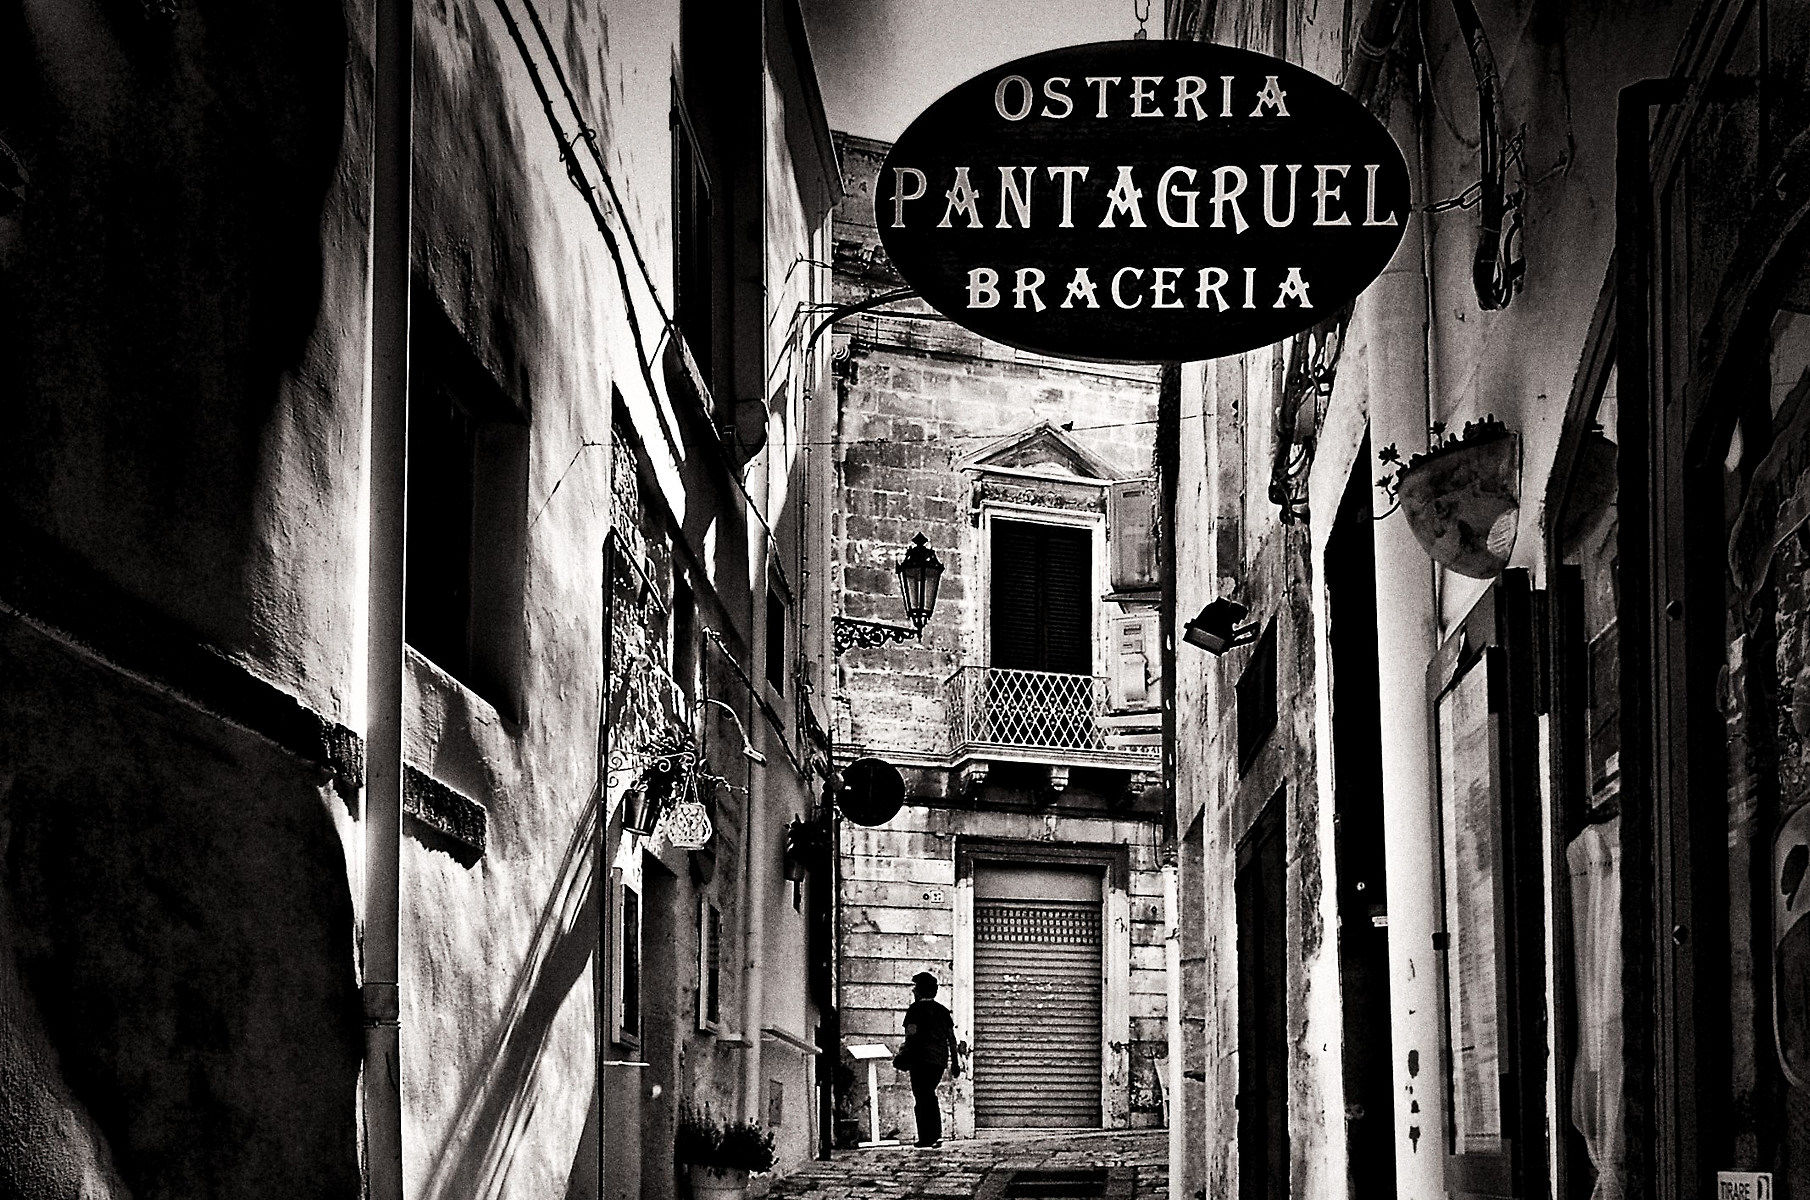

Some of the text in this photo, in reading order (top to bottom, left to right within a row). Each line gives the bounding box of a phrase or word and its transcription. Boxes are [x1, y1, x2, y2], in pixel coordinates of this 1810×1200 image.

[994, 74, 1291, 122] OSTERIA
[888, 163, 1399, 235] PANTAGRUEL
[965, 266, 1314, 313] BRACERIA
